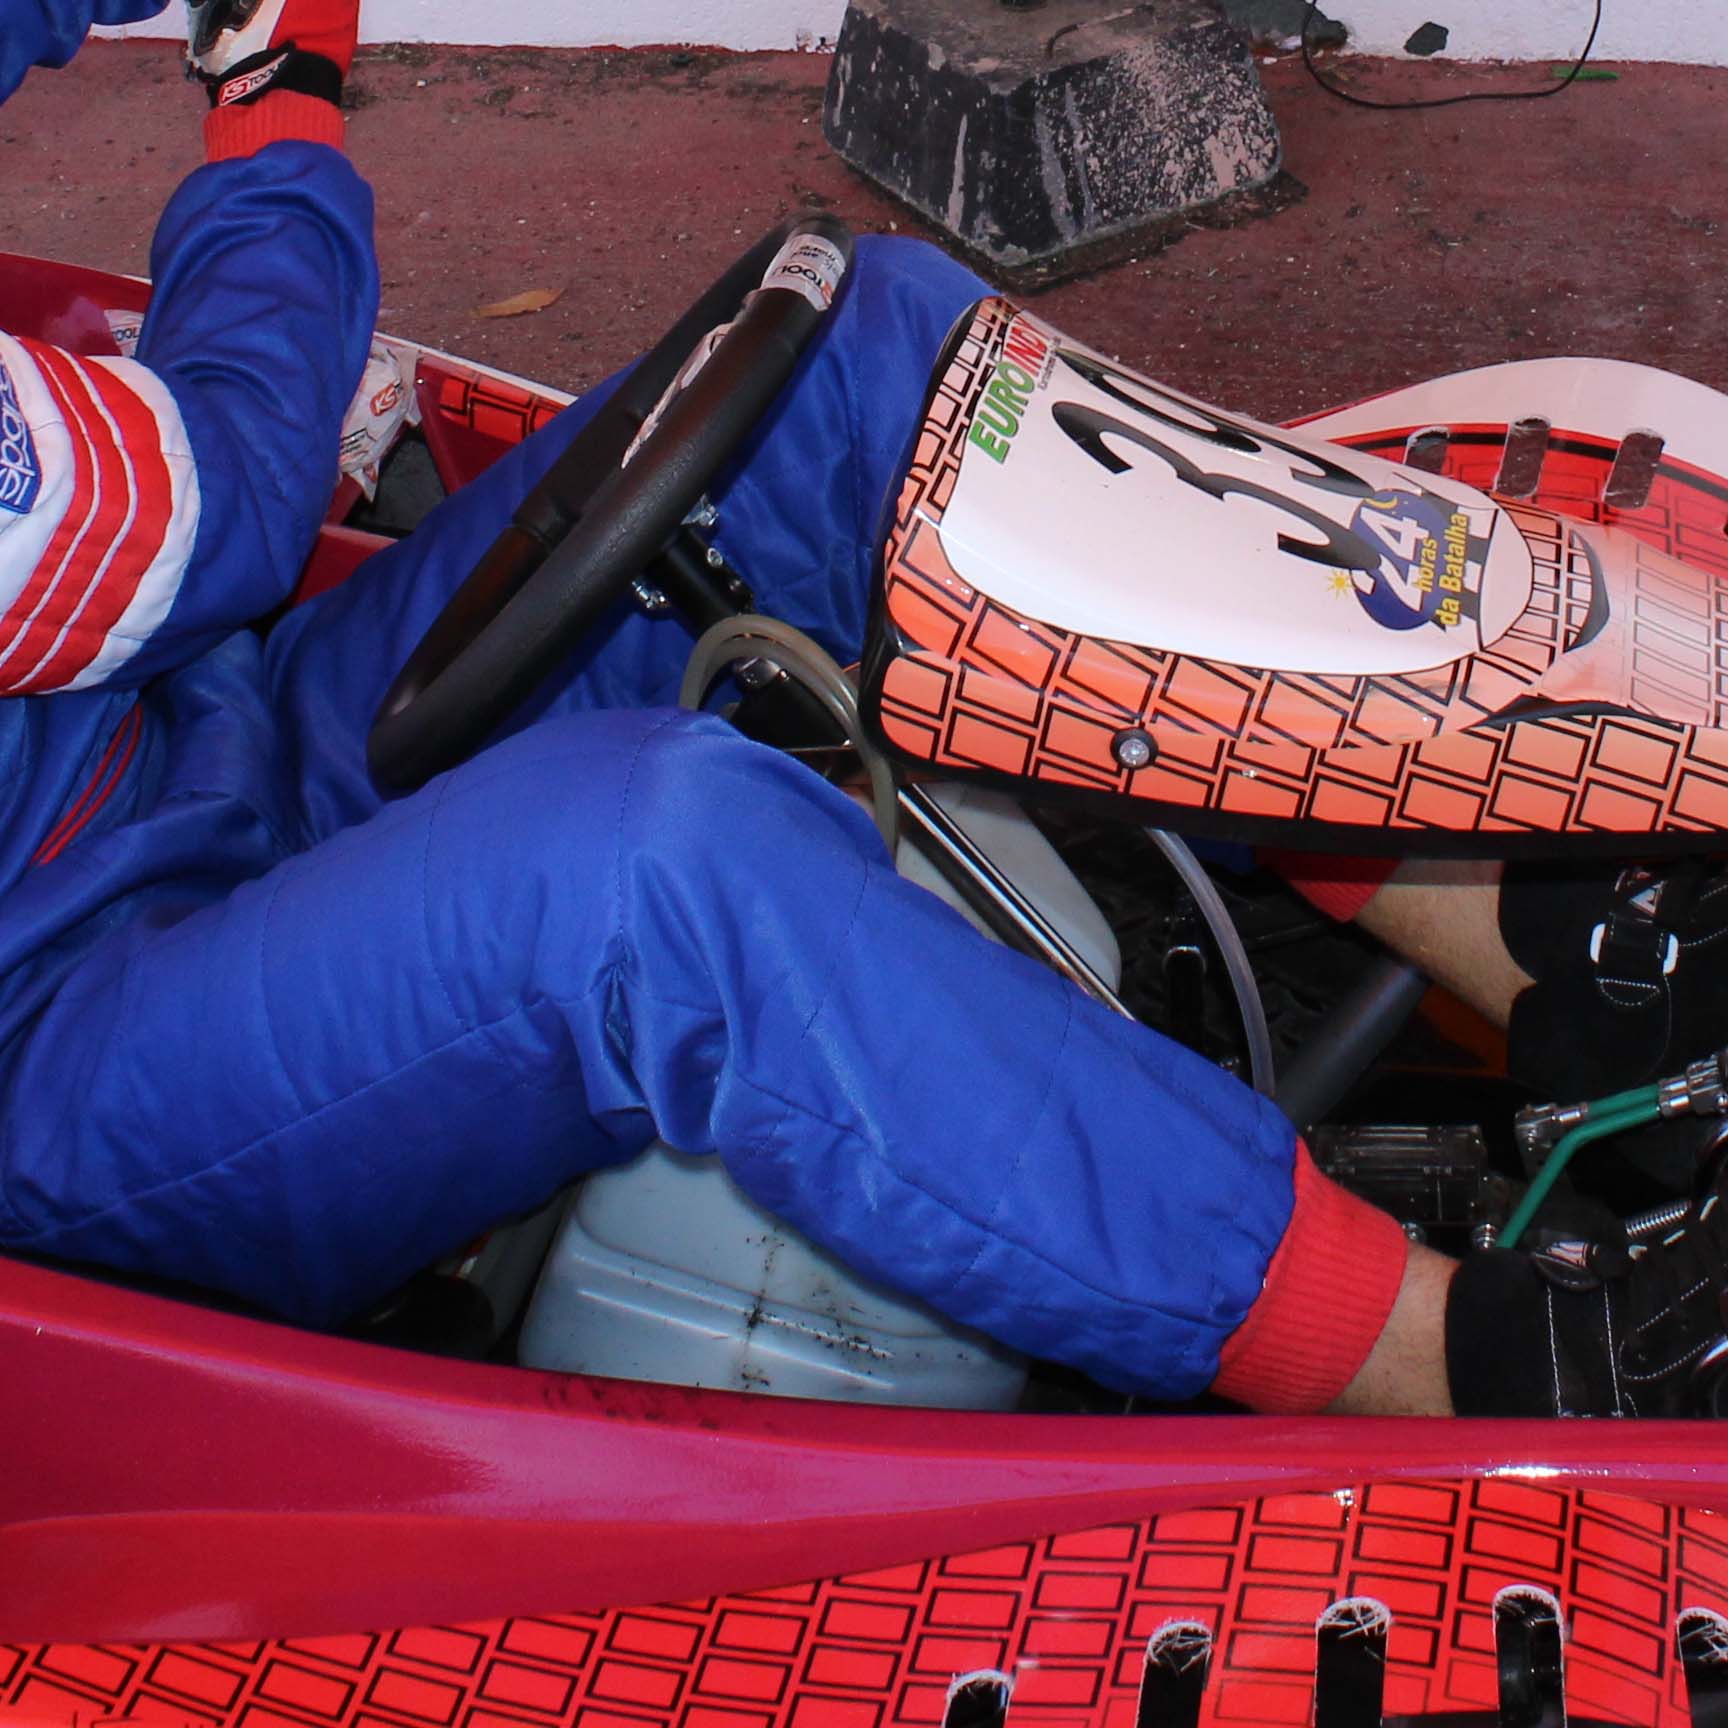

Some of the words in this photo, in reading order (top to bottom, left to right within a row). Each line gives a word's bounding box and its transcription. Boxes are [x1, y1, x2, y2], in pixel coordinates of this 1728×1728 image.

[1351, 506, 1430, 613] 24
[1413, 538, 1438, 593] horas
[1439, 513, 1469, 593] Batalha
[1436, 597, 1461, 626] da
